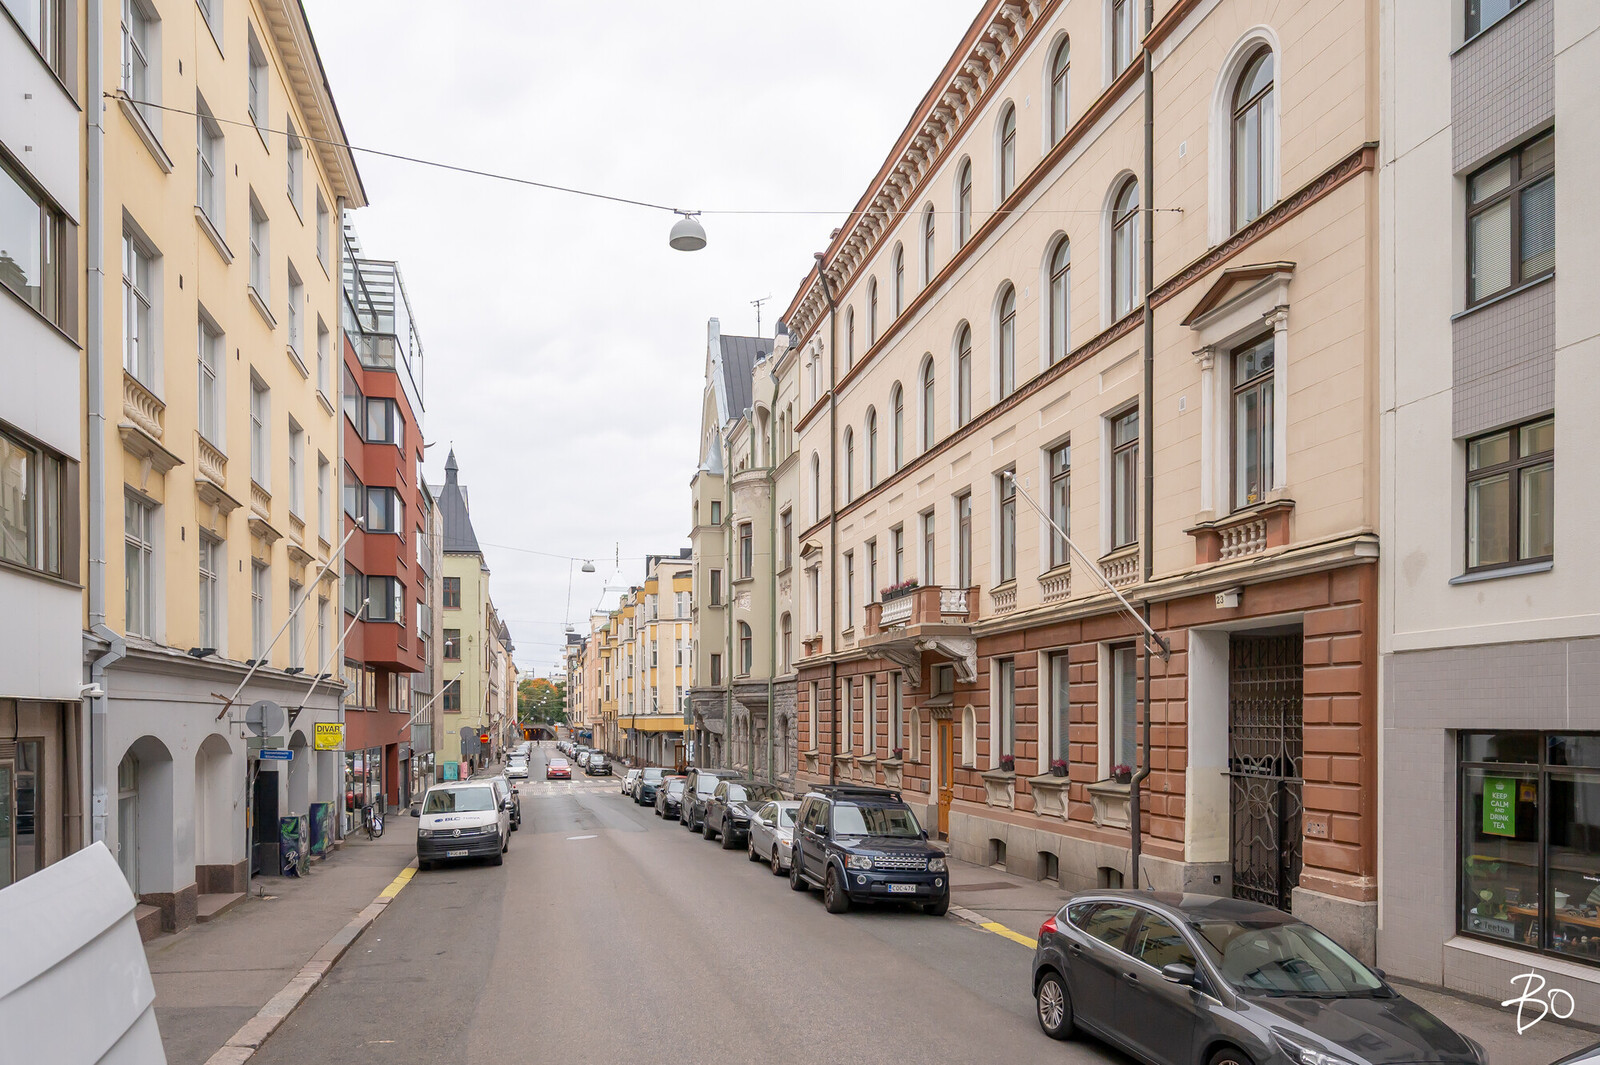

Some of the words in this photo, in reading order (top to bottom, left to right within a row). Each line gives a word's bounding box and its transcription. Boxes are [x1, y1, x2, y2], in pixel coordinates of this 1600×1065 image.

[1216, 595, 1224, 604] 23
[317, 725, 342, 733] DIVAR
[1492, 792, 1508, 800] KEEP
[1490, 800, 1509, 808] CALM
[1489, 813, 1509, 821] DRINK
[1492, 821, 1506, 829] TEA
